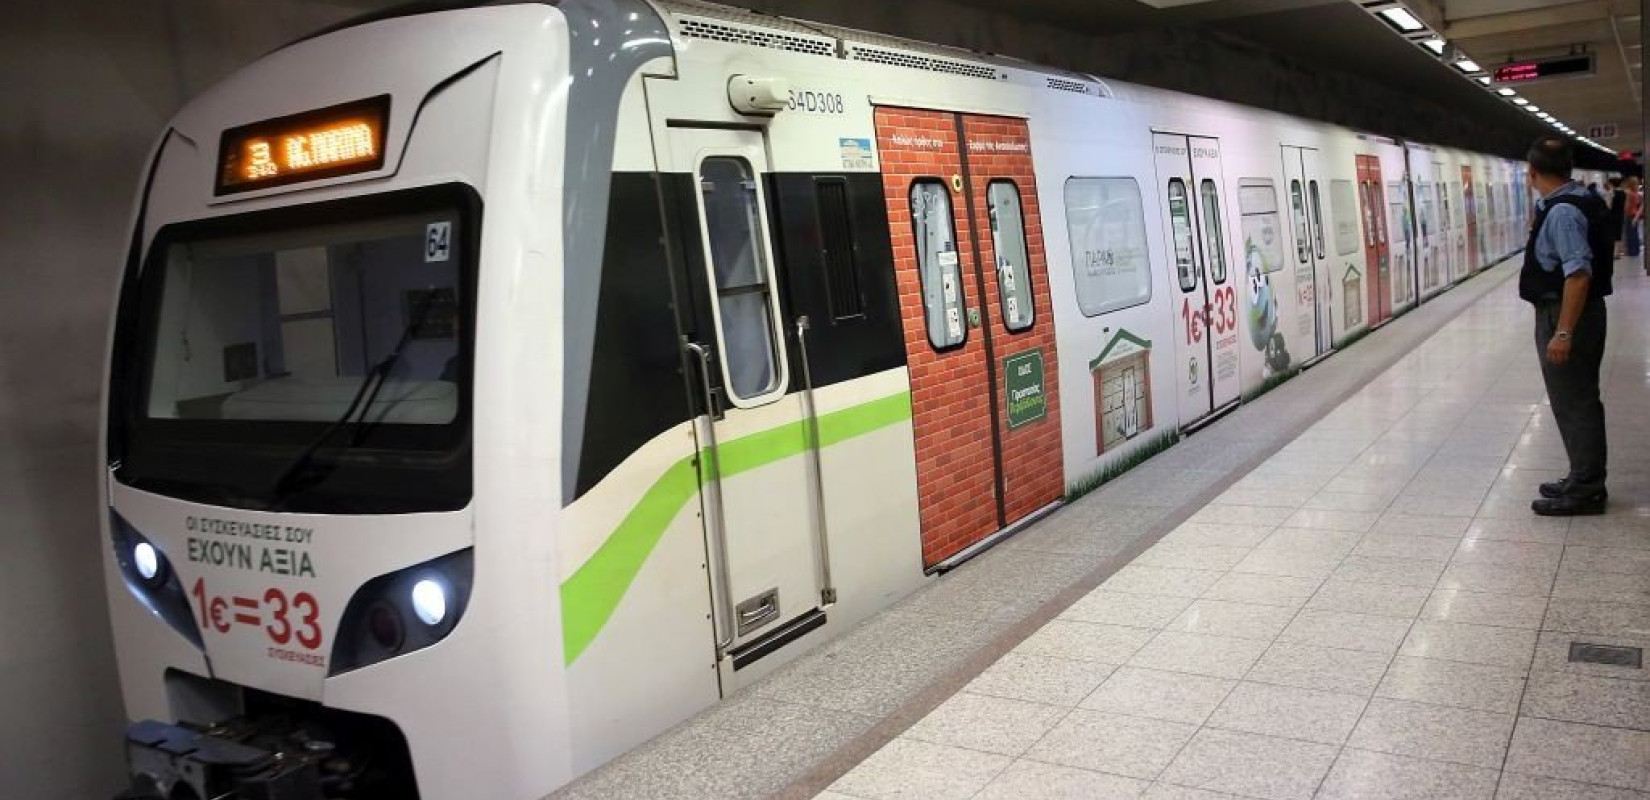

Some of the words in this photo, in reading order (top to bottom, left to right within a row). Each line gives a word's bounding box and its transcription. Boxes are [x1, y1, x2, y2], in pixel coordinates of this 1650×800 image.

[428, 226, 448, 257] 64
[185, 516, 198, 531] ΟΙ
[200, 517, 282, 541] ΣΥΣΚΕΥΑΣΙΕΣ
[284, 526, 314, 543] ΣΟΥ
[187, 537, 253, 569] ΕΧΟΥΝ
[259, 547, 316, 578] ΑΞΙΑ
